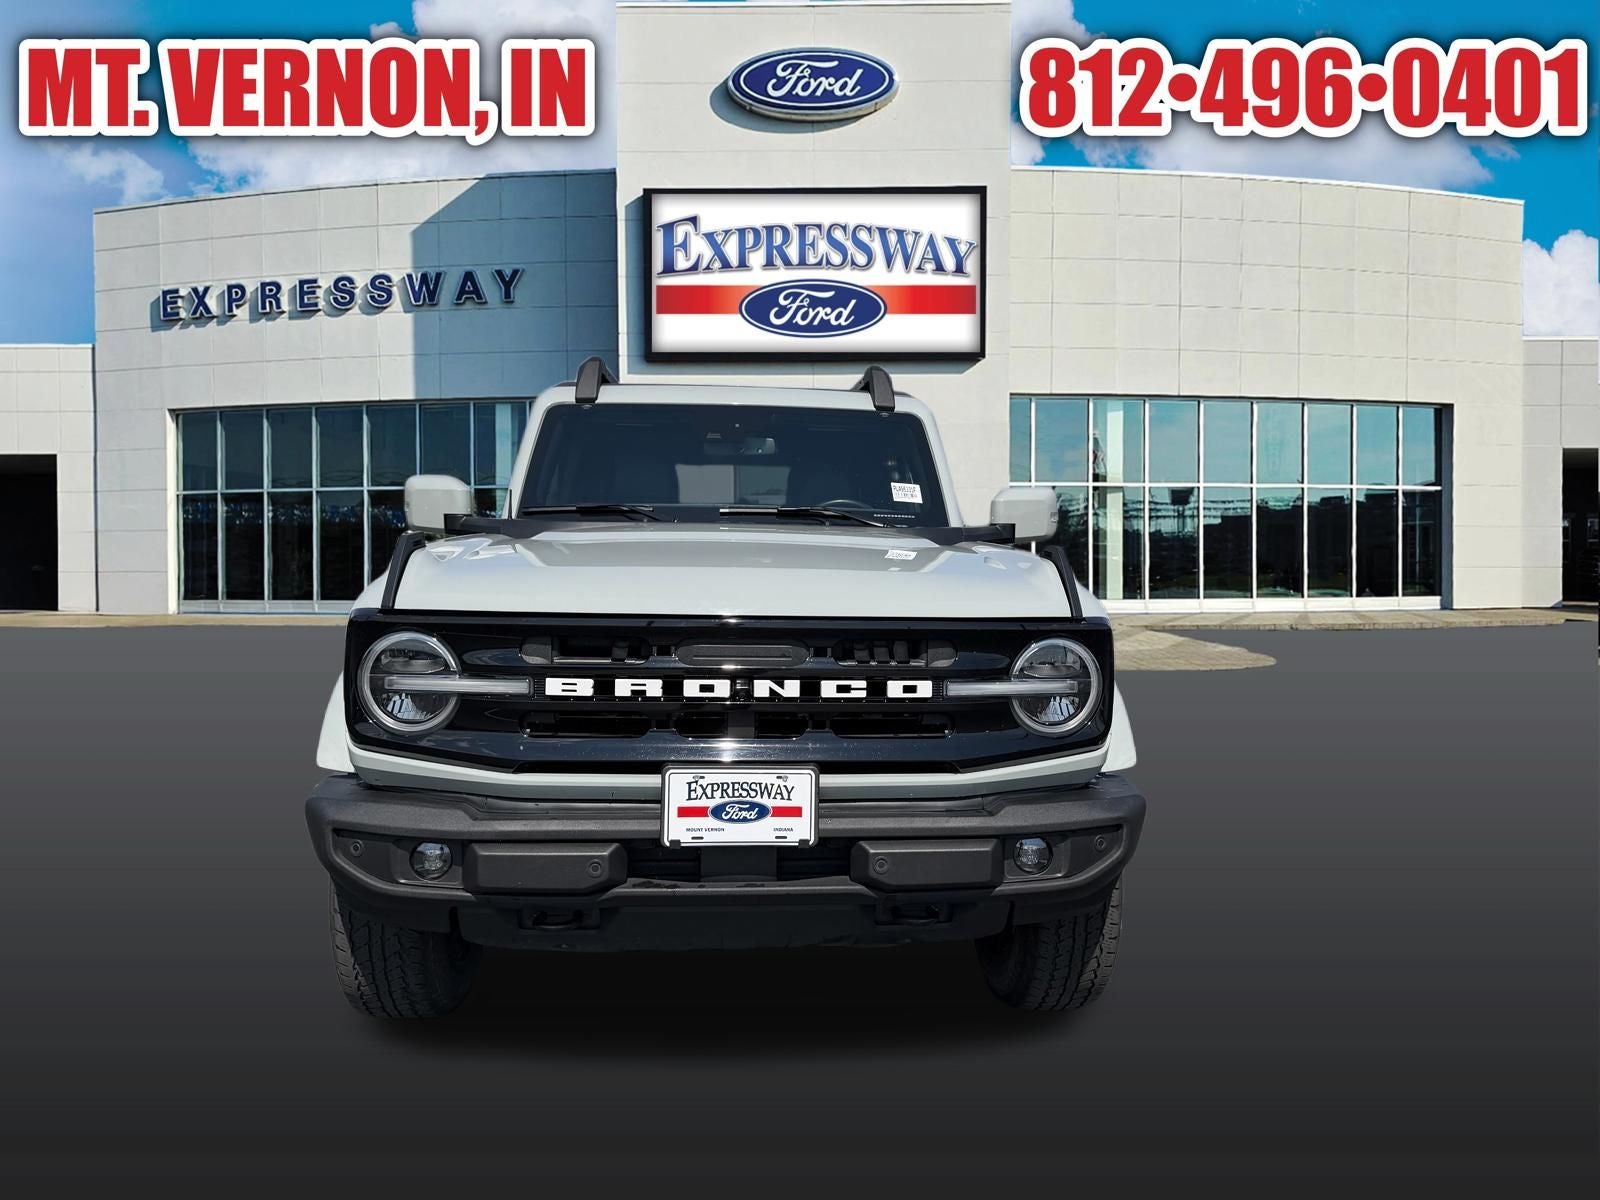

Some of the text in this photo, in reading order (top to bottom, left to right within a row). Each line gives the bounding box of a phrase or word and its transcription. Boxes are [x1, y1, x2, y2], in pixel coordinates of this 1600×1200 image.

[767, 59, 864, 97] Ford
[159, 267, 525, 321] EXPRESSWAY
[768, 288, 857, 327] Ford
[545, 677, 933, 699] BRONCO
[721, 803, 758, 820] Ford
